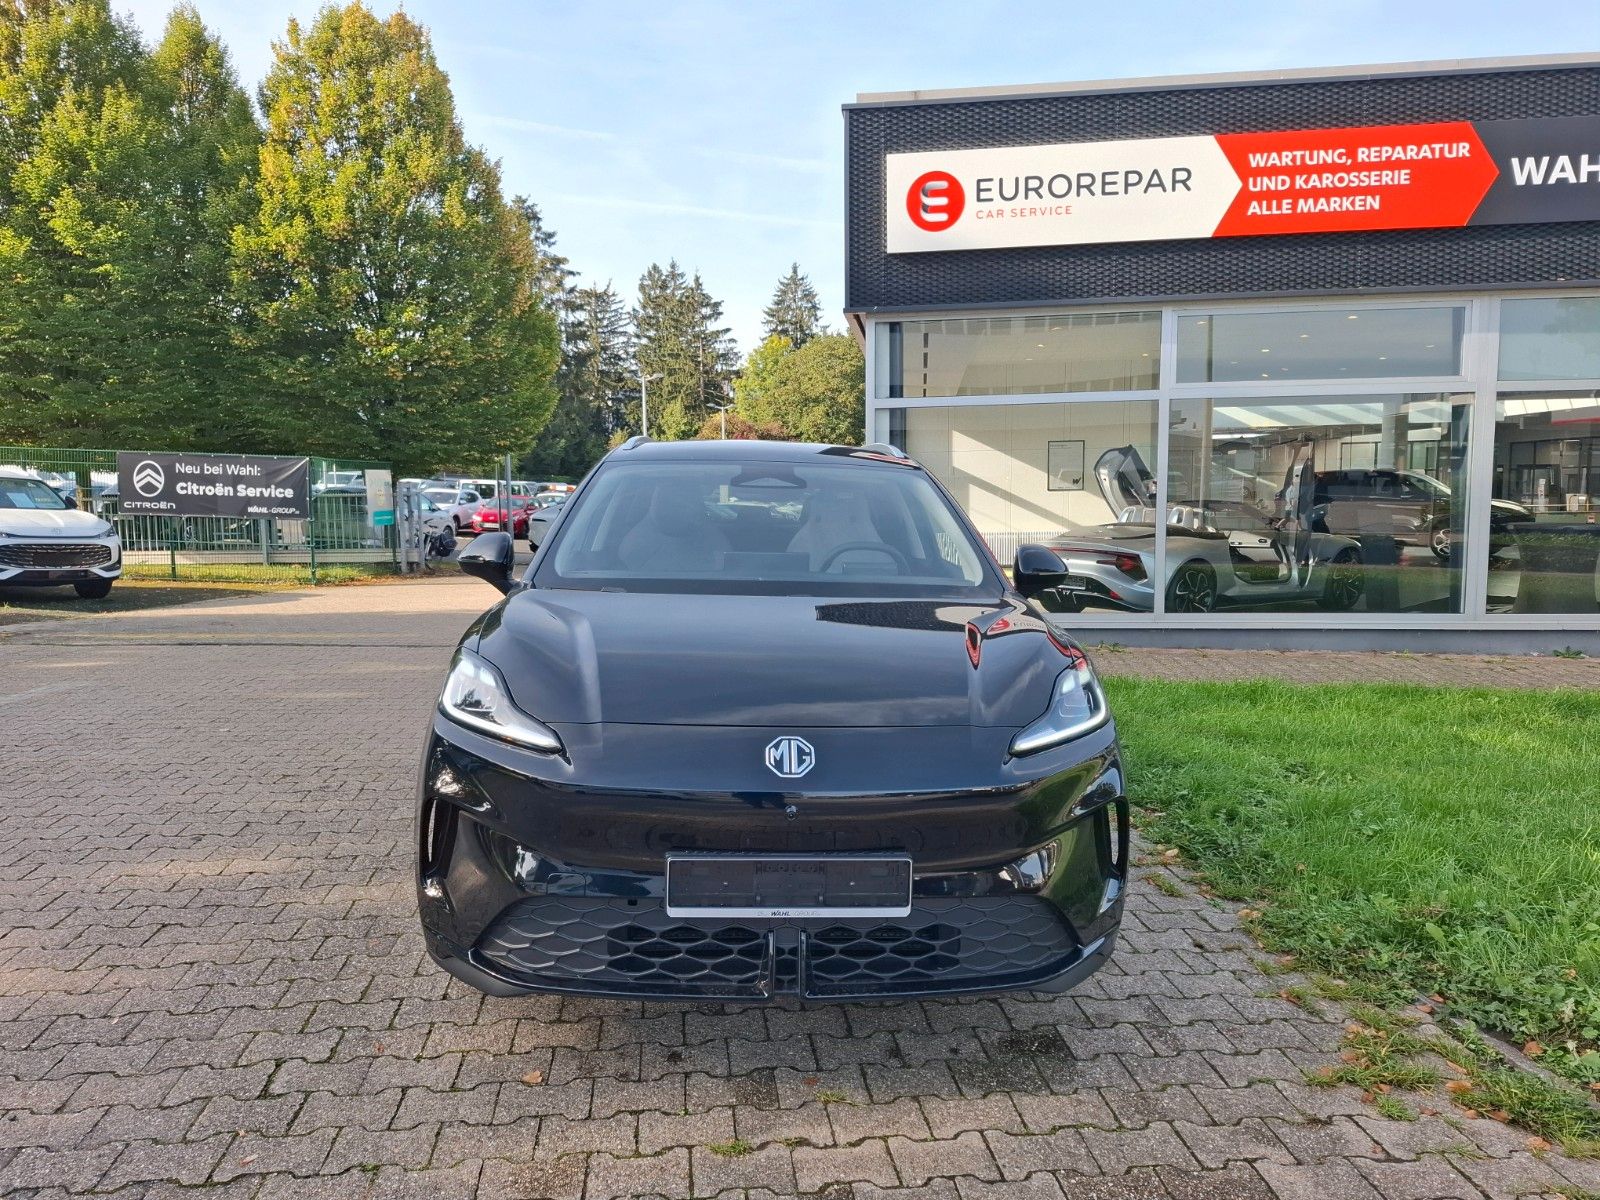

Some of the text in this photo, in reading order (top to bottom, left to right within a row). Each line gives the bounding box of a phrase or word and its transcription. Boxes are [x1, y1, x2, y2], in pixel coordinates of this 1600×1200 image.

[1248, 141, 1471, 168] WARTUNG, REPARATUR
[1249, 169, 1411, 192] UND KAROSSERIE
[1511, 153, 1600, 186] WAH
[976, 167, 1193, 203] EUROREPAR
[976, 205, 1073, 220] CAR SERVICE
[1247, 195, 1381, 216] ALLE MARKEN
[175, 462, 261, 477] Neu bei Wahl:
[176, 482, 294, 499] Citroën Service
[769, 739, 811, 774] MG
